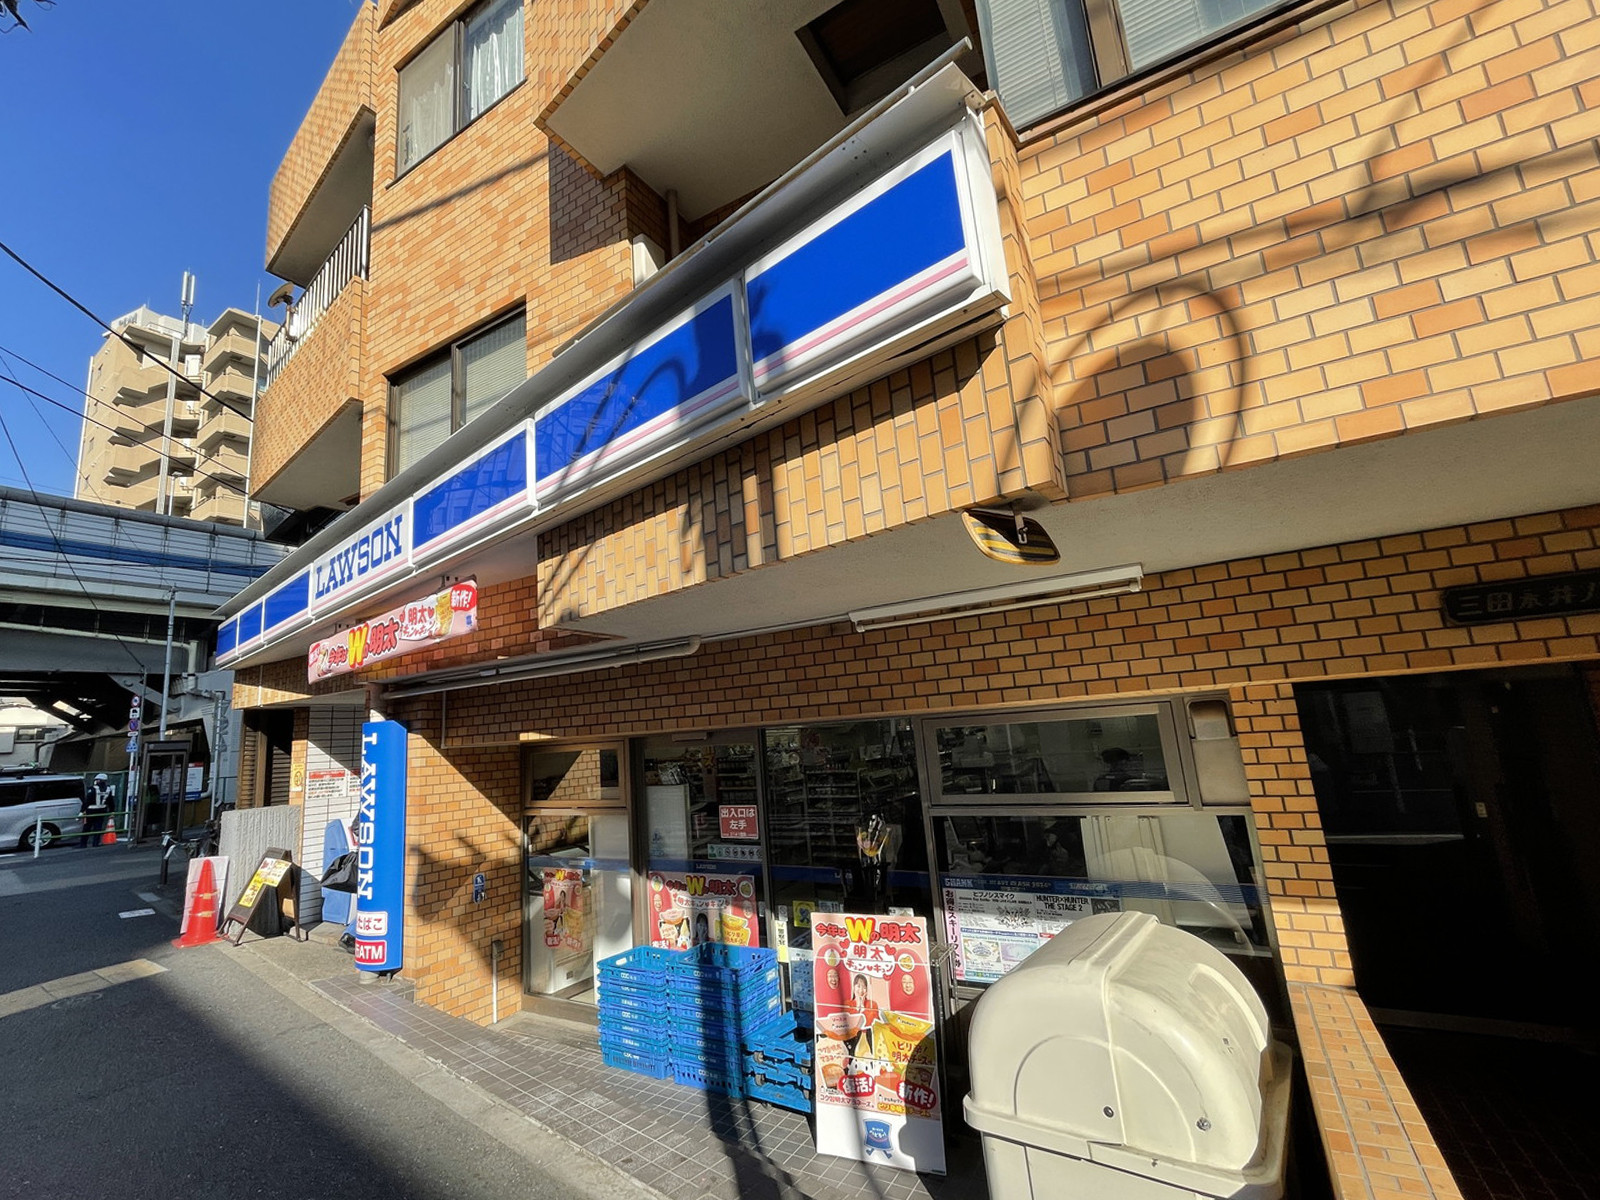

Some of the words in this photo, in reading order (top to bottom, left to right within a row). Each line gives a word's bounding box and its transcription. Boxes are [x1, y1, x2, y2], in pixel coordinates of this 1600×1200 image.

[315, 514, 403, 600] LAWSON
[408, 605, 428, 625] 明太
[357, 732, 378, 900] LAWSON
[720, 807, 756, 818] 出入口は
[729, 819, 748, 830] 左手
[1044, 902, 1056, 910] THE
[815, 917, 921, 944] 今年はWの明太
[853, 944, 884, 961] 明太
[843, 1077, 873, 1097] 復活!
[899, 1081, 935, 1108] 新作!
